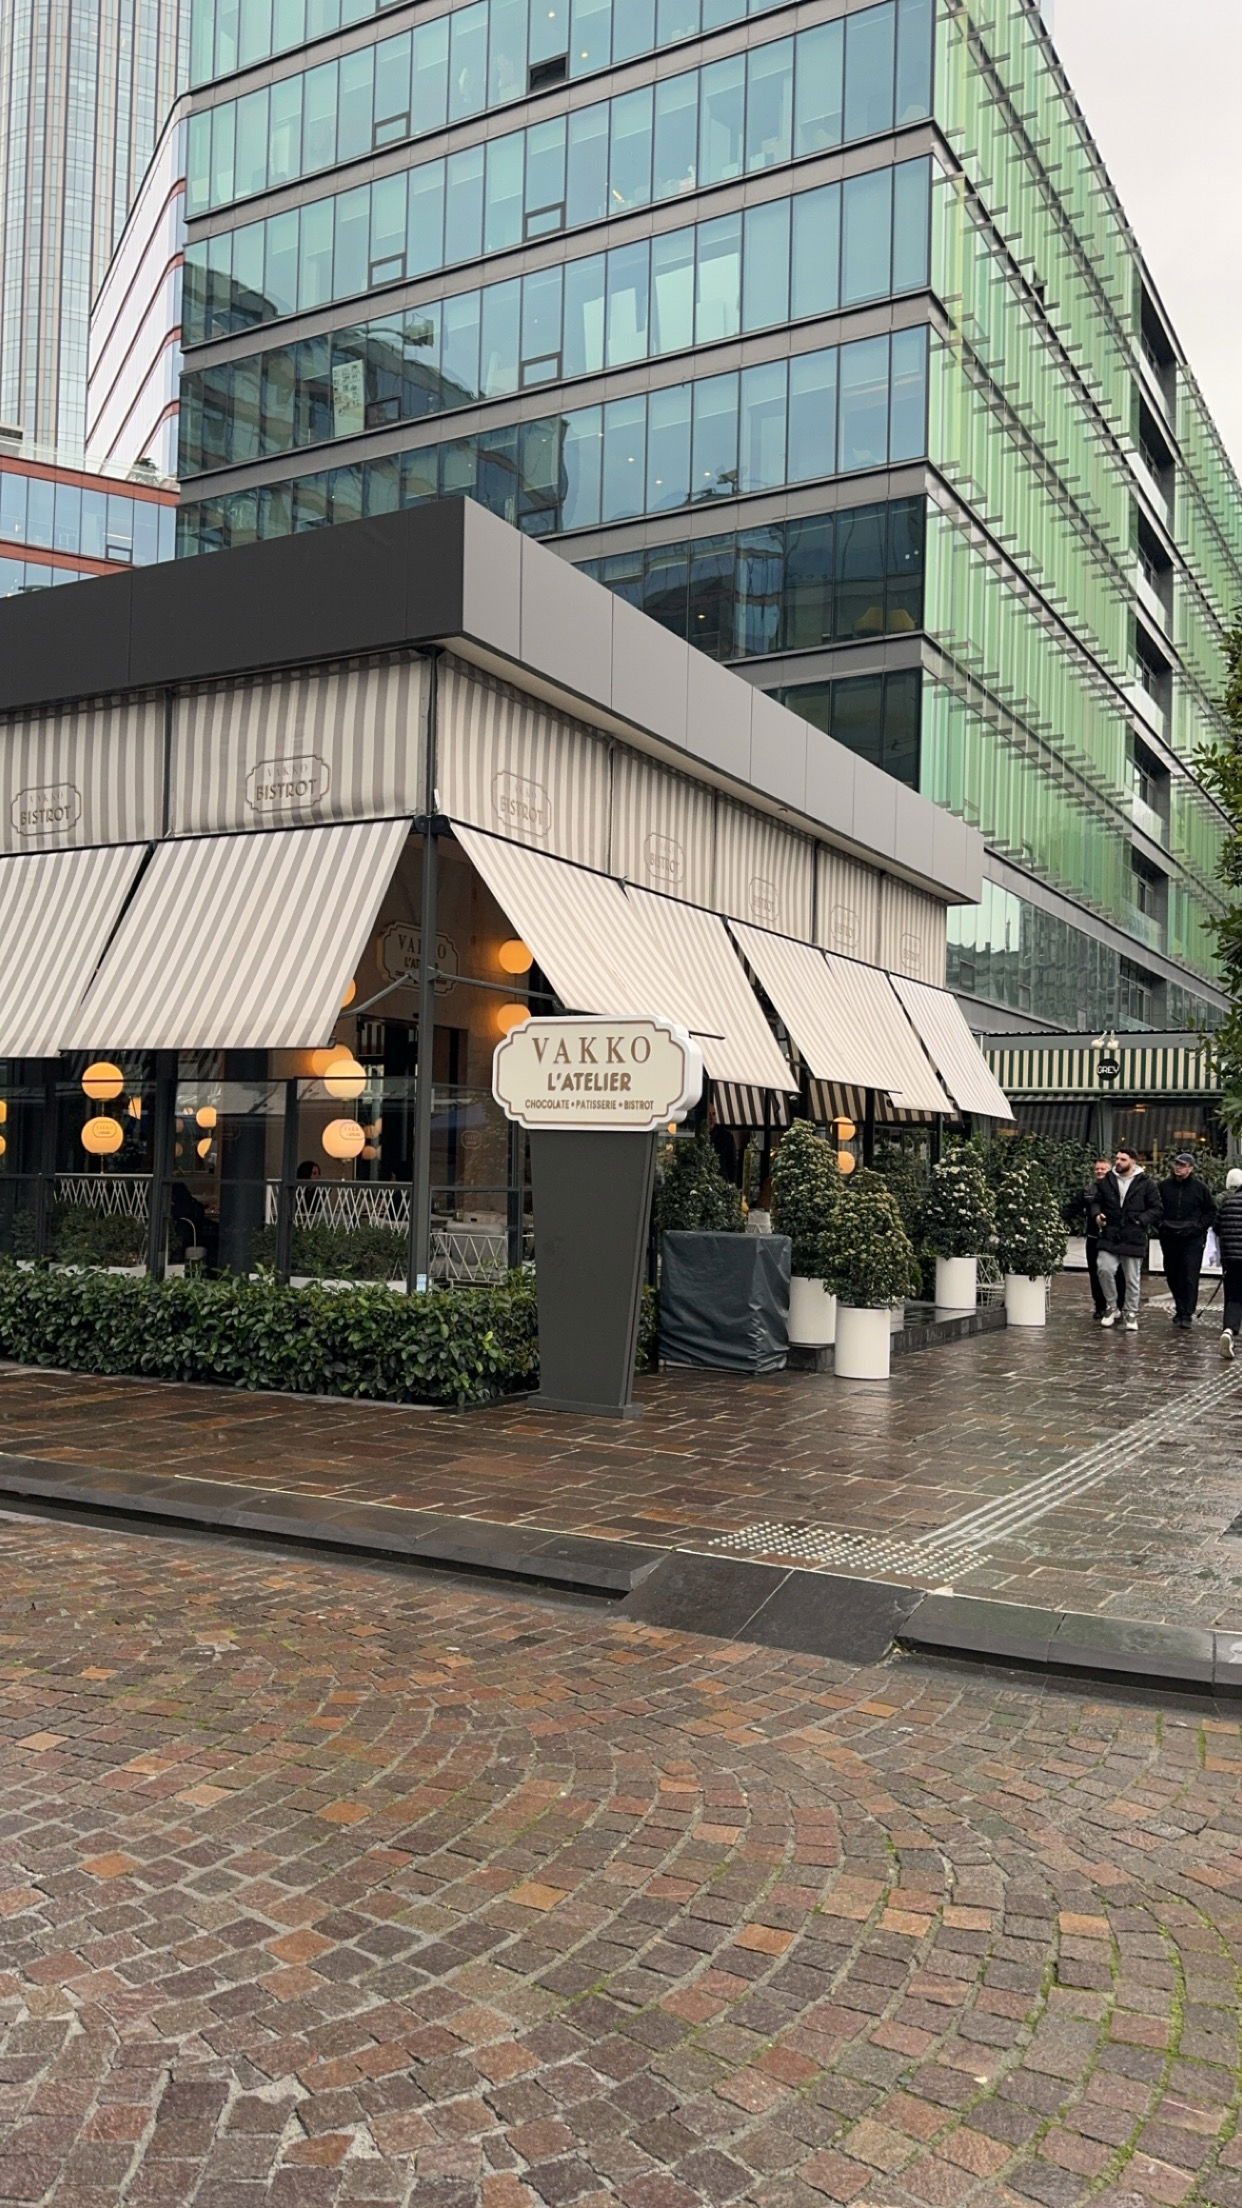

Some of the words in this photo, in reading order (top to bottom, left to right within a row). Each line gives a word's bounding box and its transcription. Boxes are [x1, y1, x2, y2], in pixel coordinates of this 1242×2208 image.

[256, 779, 317, 801] BISTROT
[20, 805, 71, 826] BISTROT
[398, 934, 447, 959] VAO
[532, 1036, 652, 1063] VAKKO
[1098, 1065, 1120, 1074] GREY
[547, 1072, 632, 1092] L'ATELIER
[525, 1099, 570, 1110] CHOCOLATE
[575, 1099, 617, 1110] PATISSERIE
[624, 1100, 654, 1110] BISTROT
